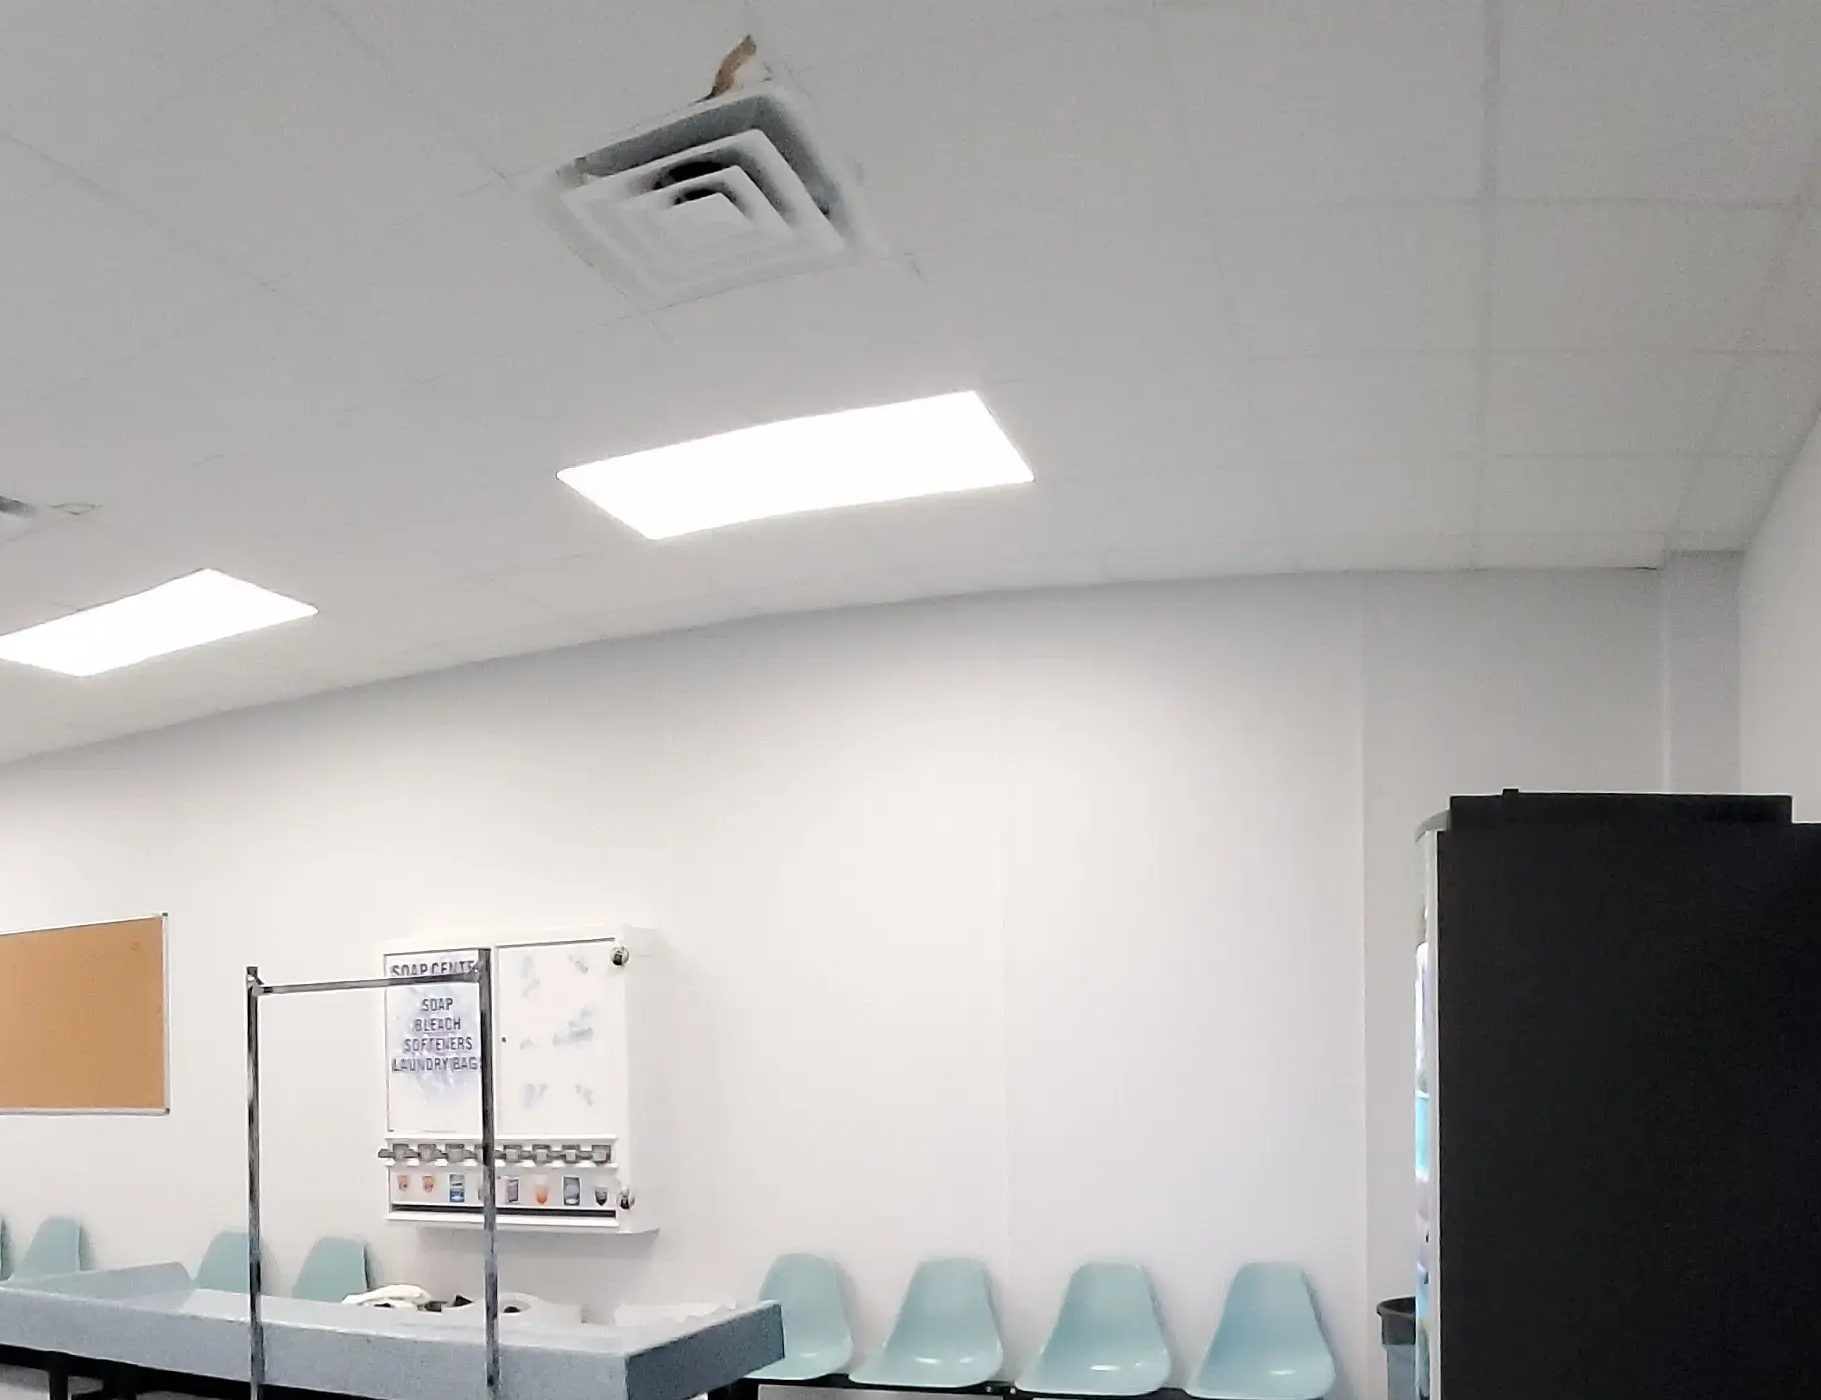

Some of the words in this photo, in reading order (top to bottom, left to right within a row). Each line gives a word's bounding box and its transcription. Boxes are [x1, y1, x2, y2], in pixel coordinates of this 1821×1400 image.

[391, 963, 428, 976] SOAP
[431, 960, 475, 976] CENTE
[421, 997, 454, 1012] SOAP
[414, 1017, 461, 1032] BLEACH
[403, 1036, 473, 1052] SOFTENERS
[391, 1057, 448, 1073] LAUNDRY
[452, 1056, 481, 1071] BAG
